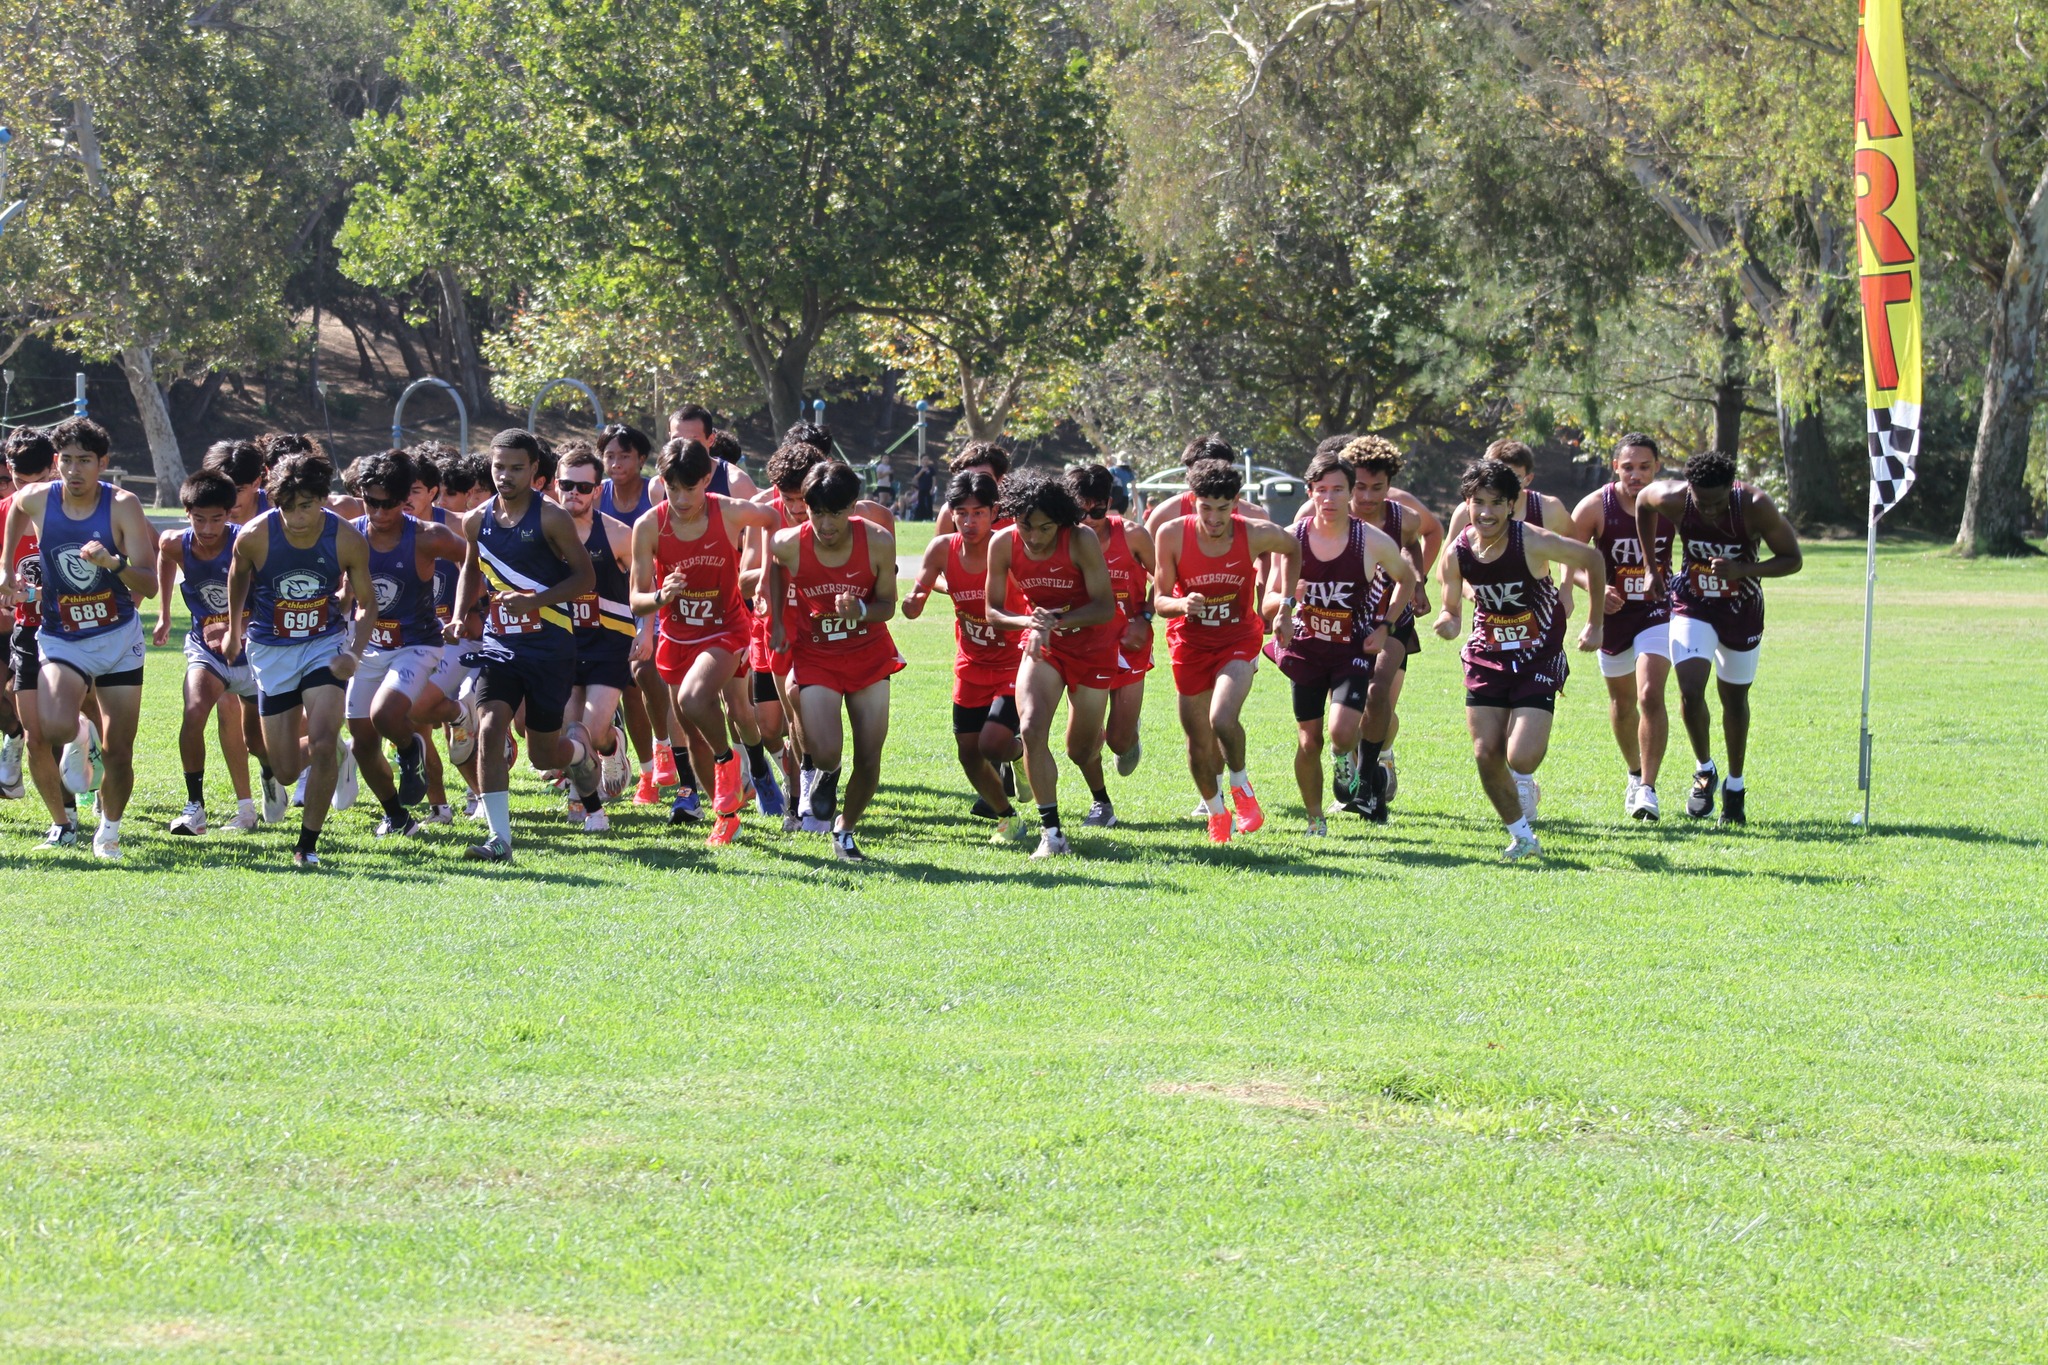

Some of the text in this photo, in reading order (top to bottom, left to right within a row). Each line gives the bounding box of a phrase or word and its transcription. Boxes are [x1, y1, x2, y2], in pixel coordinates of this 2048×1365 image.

[1185, 573, 1245, 587] BAKERSFIELD
[1624, 577, 1645, 593] 66
[1698, 574, 1729, 591] 661
[680, 590, 705, 598] thletic
[69, 602, 108, 622] 688
[679, 598, 714, 618] 672
[283, 610, 320, 630] 696
[821, 618, 857, 634] 670
[1310, 615, 1342, 635] 664
[371, 628, 392, 643] 84
[965, 620, 997, 640] 674
[1493, 625, 1531, 642] 662
